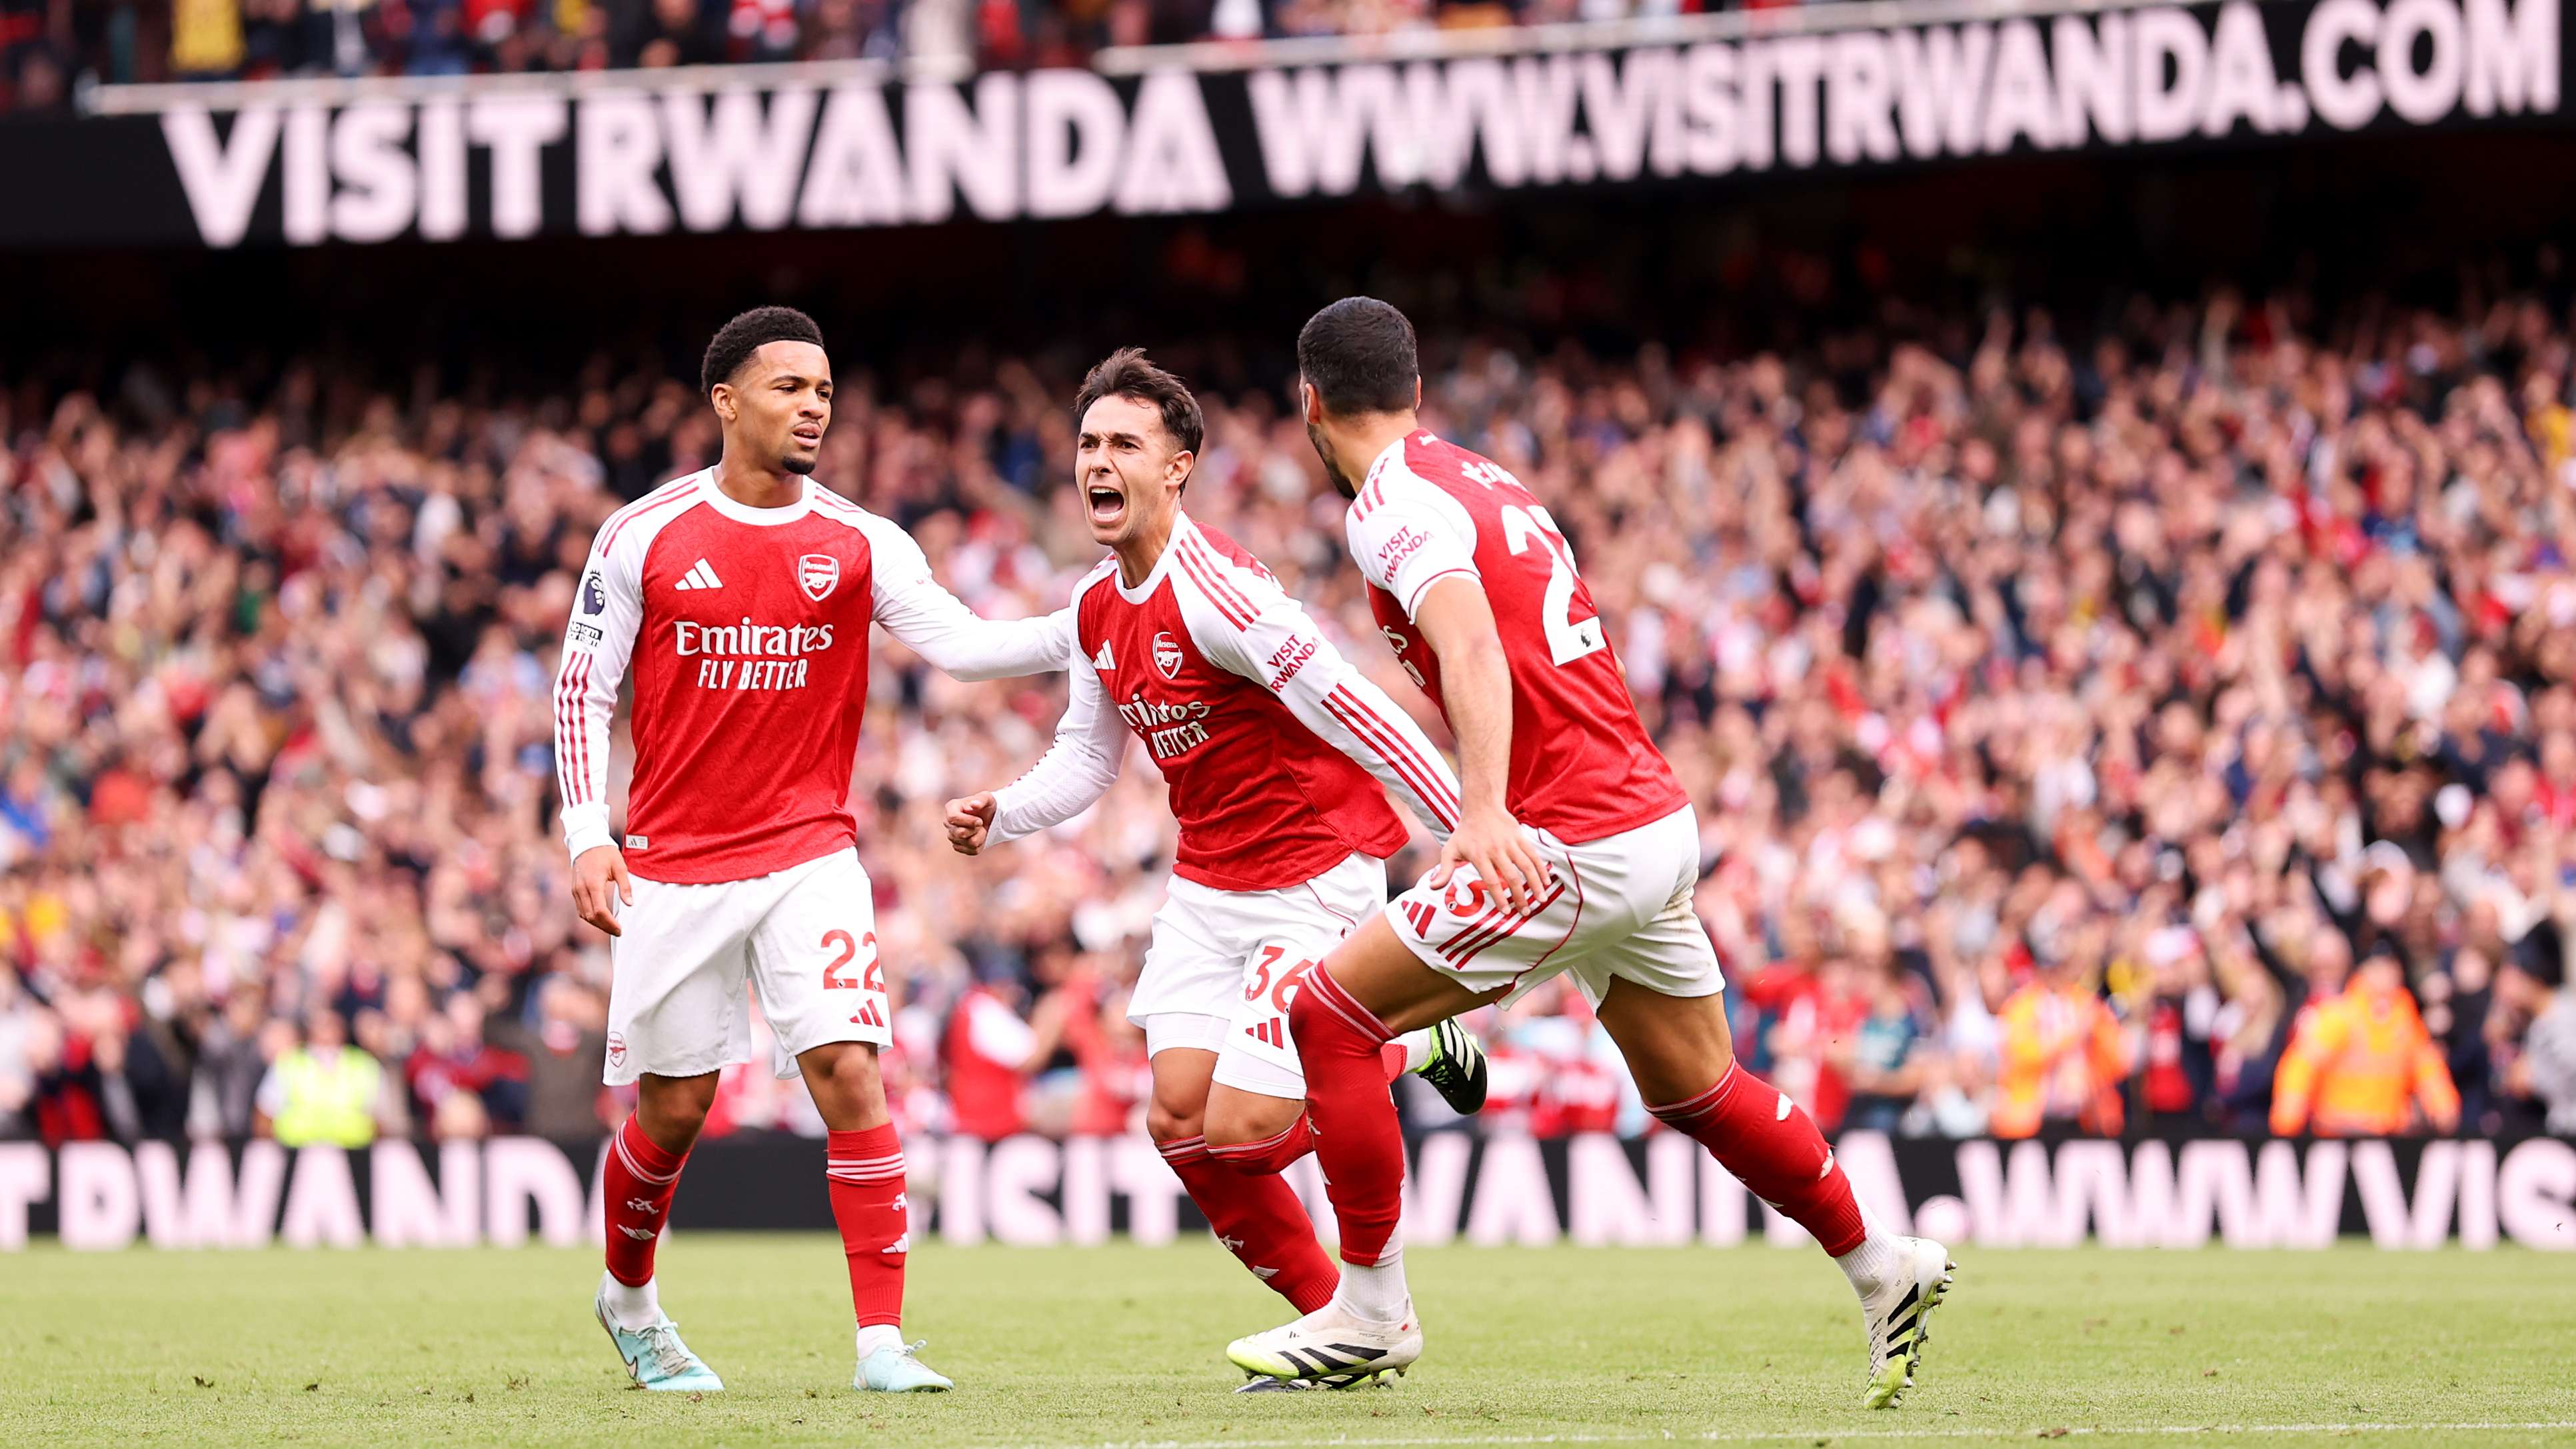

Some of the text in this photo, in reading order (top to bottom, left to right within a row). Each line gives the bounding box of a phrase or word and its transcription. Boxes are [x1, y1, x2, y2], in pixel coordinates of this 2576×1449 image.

[1378, 525, 1410, 560] VISIT
[673, 617, 833, 656] Emirates
[1267, 635, 1300, 668] VISIT
[697, 659, 808, 691] FLY BETTER
[1270, 637, 1320, 693] RWANDA
[1151, 721, 1210, 759] BETTER
[820, 929, 885, 993] 22
[1245, 946, 1314, 1015] 36
